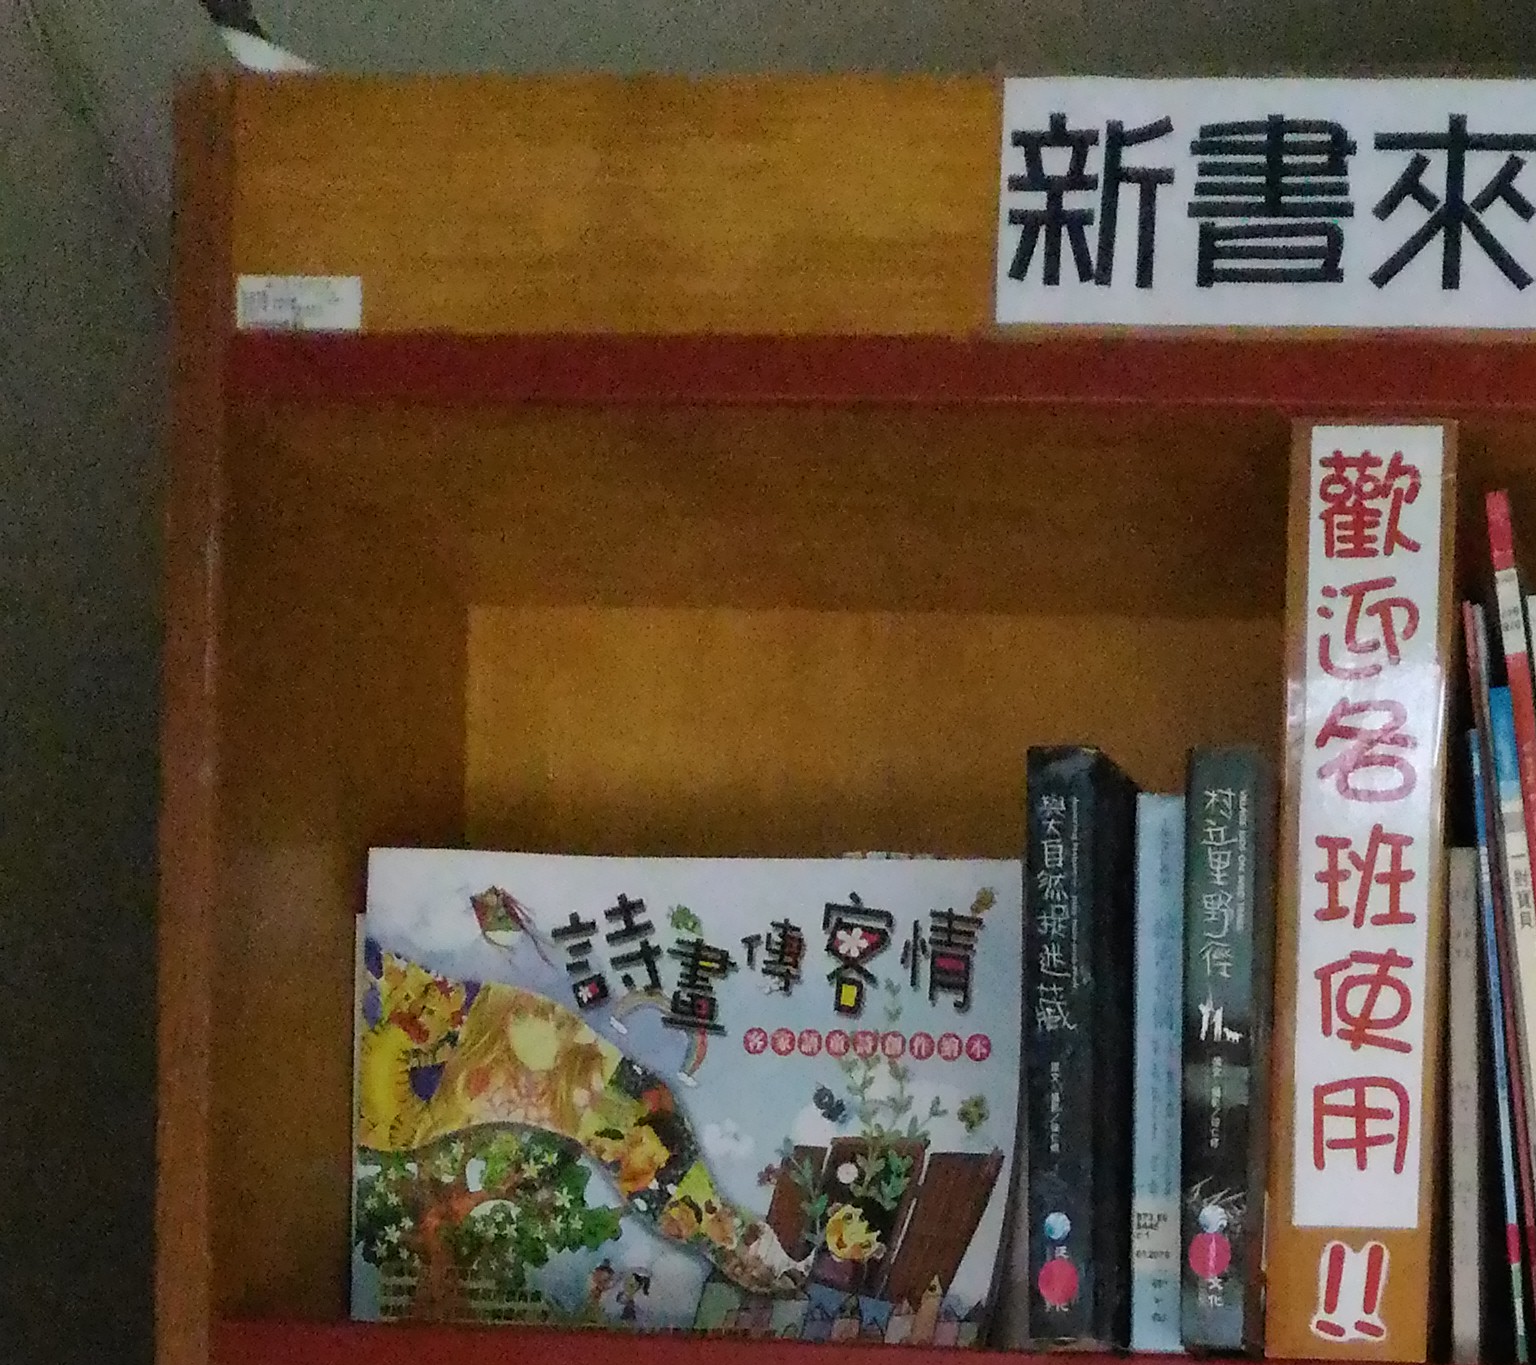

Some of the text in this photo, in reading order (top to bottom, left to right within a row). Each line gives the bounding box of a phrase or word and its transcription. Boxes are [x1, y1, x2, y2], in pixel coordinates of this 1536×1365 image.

[1313, 449, 1424, 1174] 歡迎各班使用
